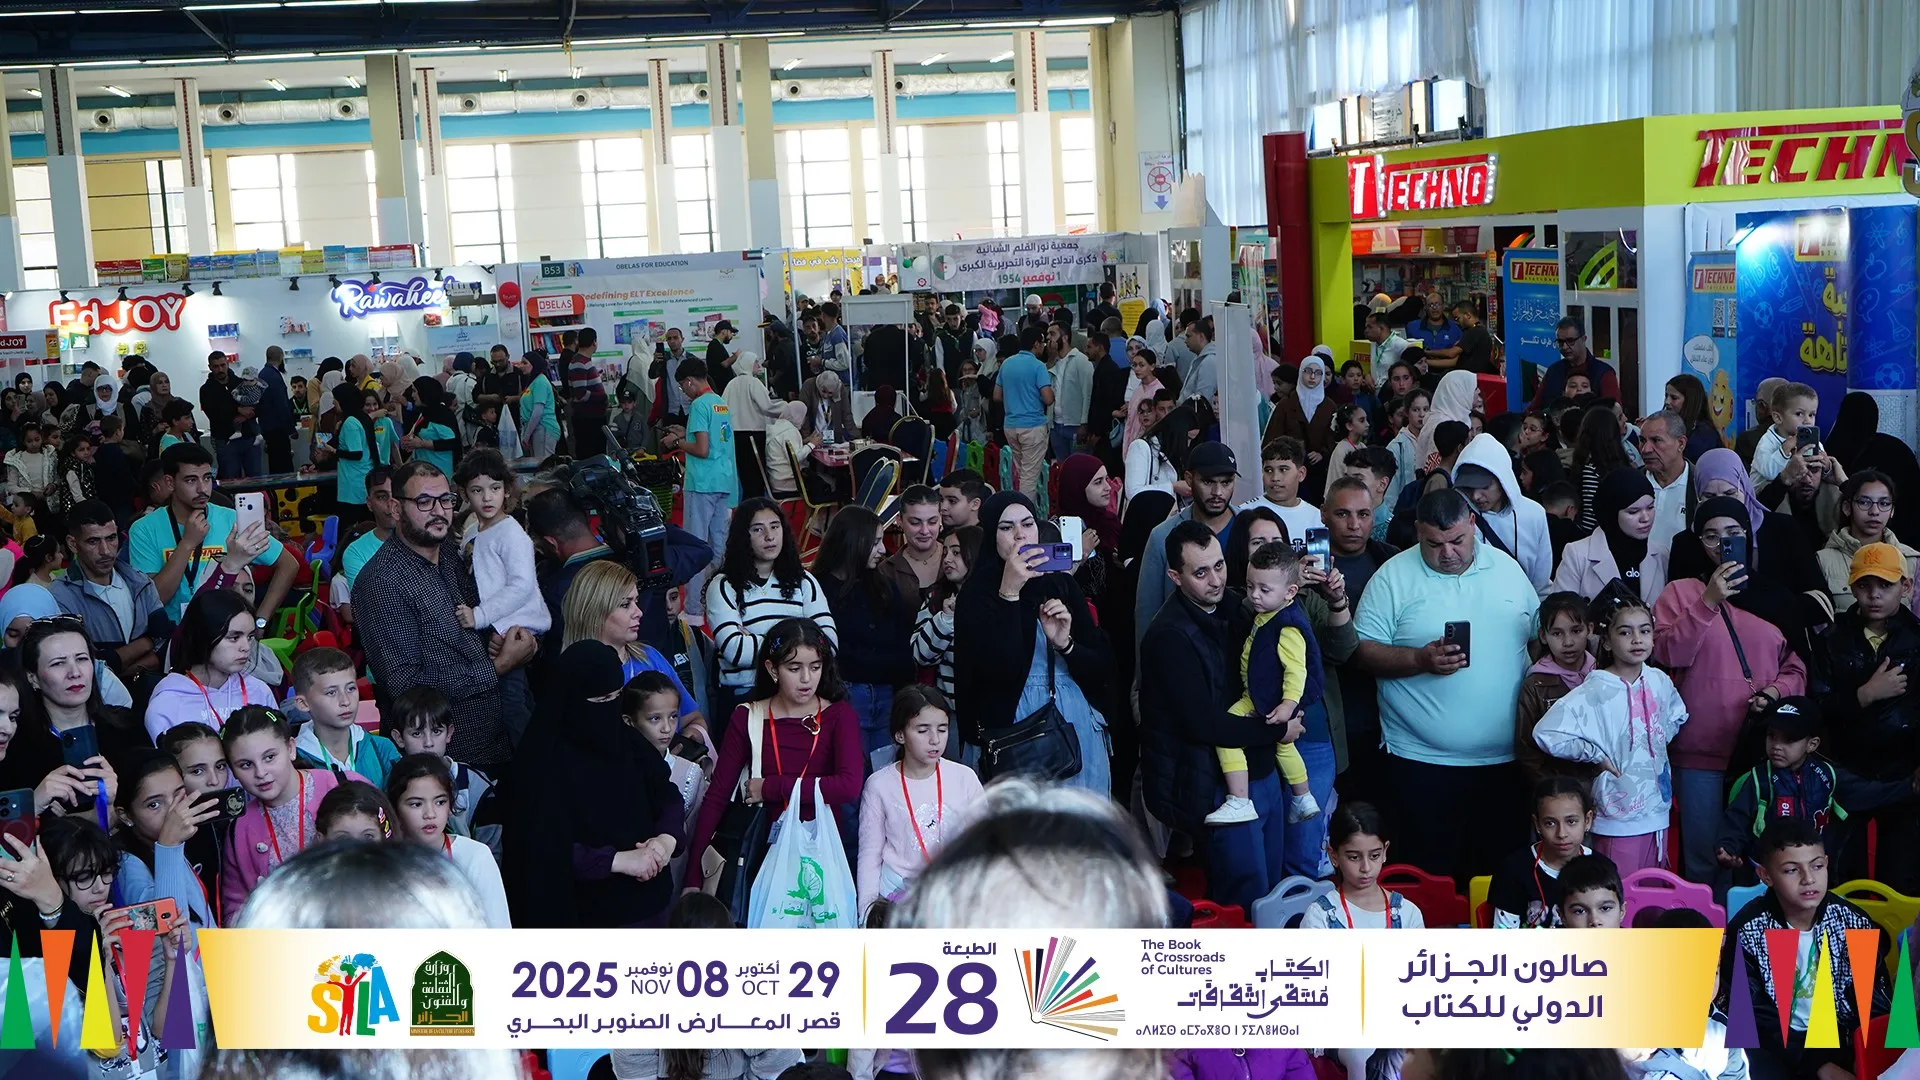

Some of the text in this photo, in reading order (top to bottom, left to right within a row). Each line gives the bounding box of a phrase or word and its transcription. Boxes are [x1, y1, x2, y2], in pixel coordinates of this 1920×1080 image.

[1693, 118, 1906, 188] TECHN
[1383, 154, 1488, 212] TECHNO
[1013, 242, 1036, 255] القلم
[1038, 243, 1049, 253] نور
[1051, 241, 1079, 251] جمعية
[616, 260, 689, 270] OBELAS FOR EDUCATION
[958, 260, 987, 272] الكبرى
[987, 258, 1024, 271] التحريرية
[1025, 256, 1050, 268] الثورة
[1051, 255, 1074, 268] اندلاع
[1075, 254, 1098, 266] ذكرى
[998, 273, 1021, 284] 1954
[1022, 272, 1055, 285] نوفمبر
[630, 289, 645, 299] ELT
[646, 287, 696, 298] Excellence
